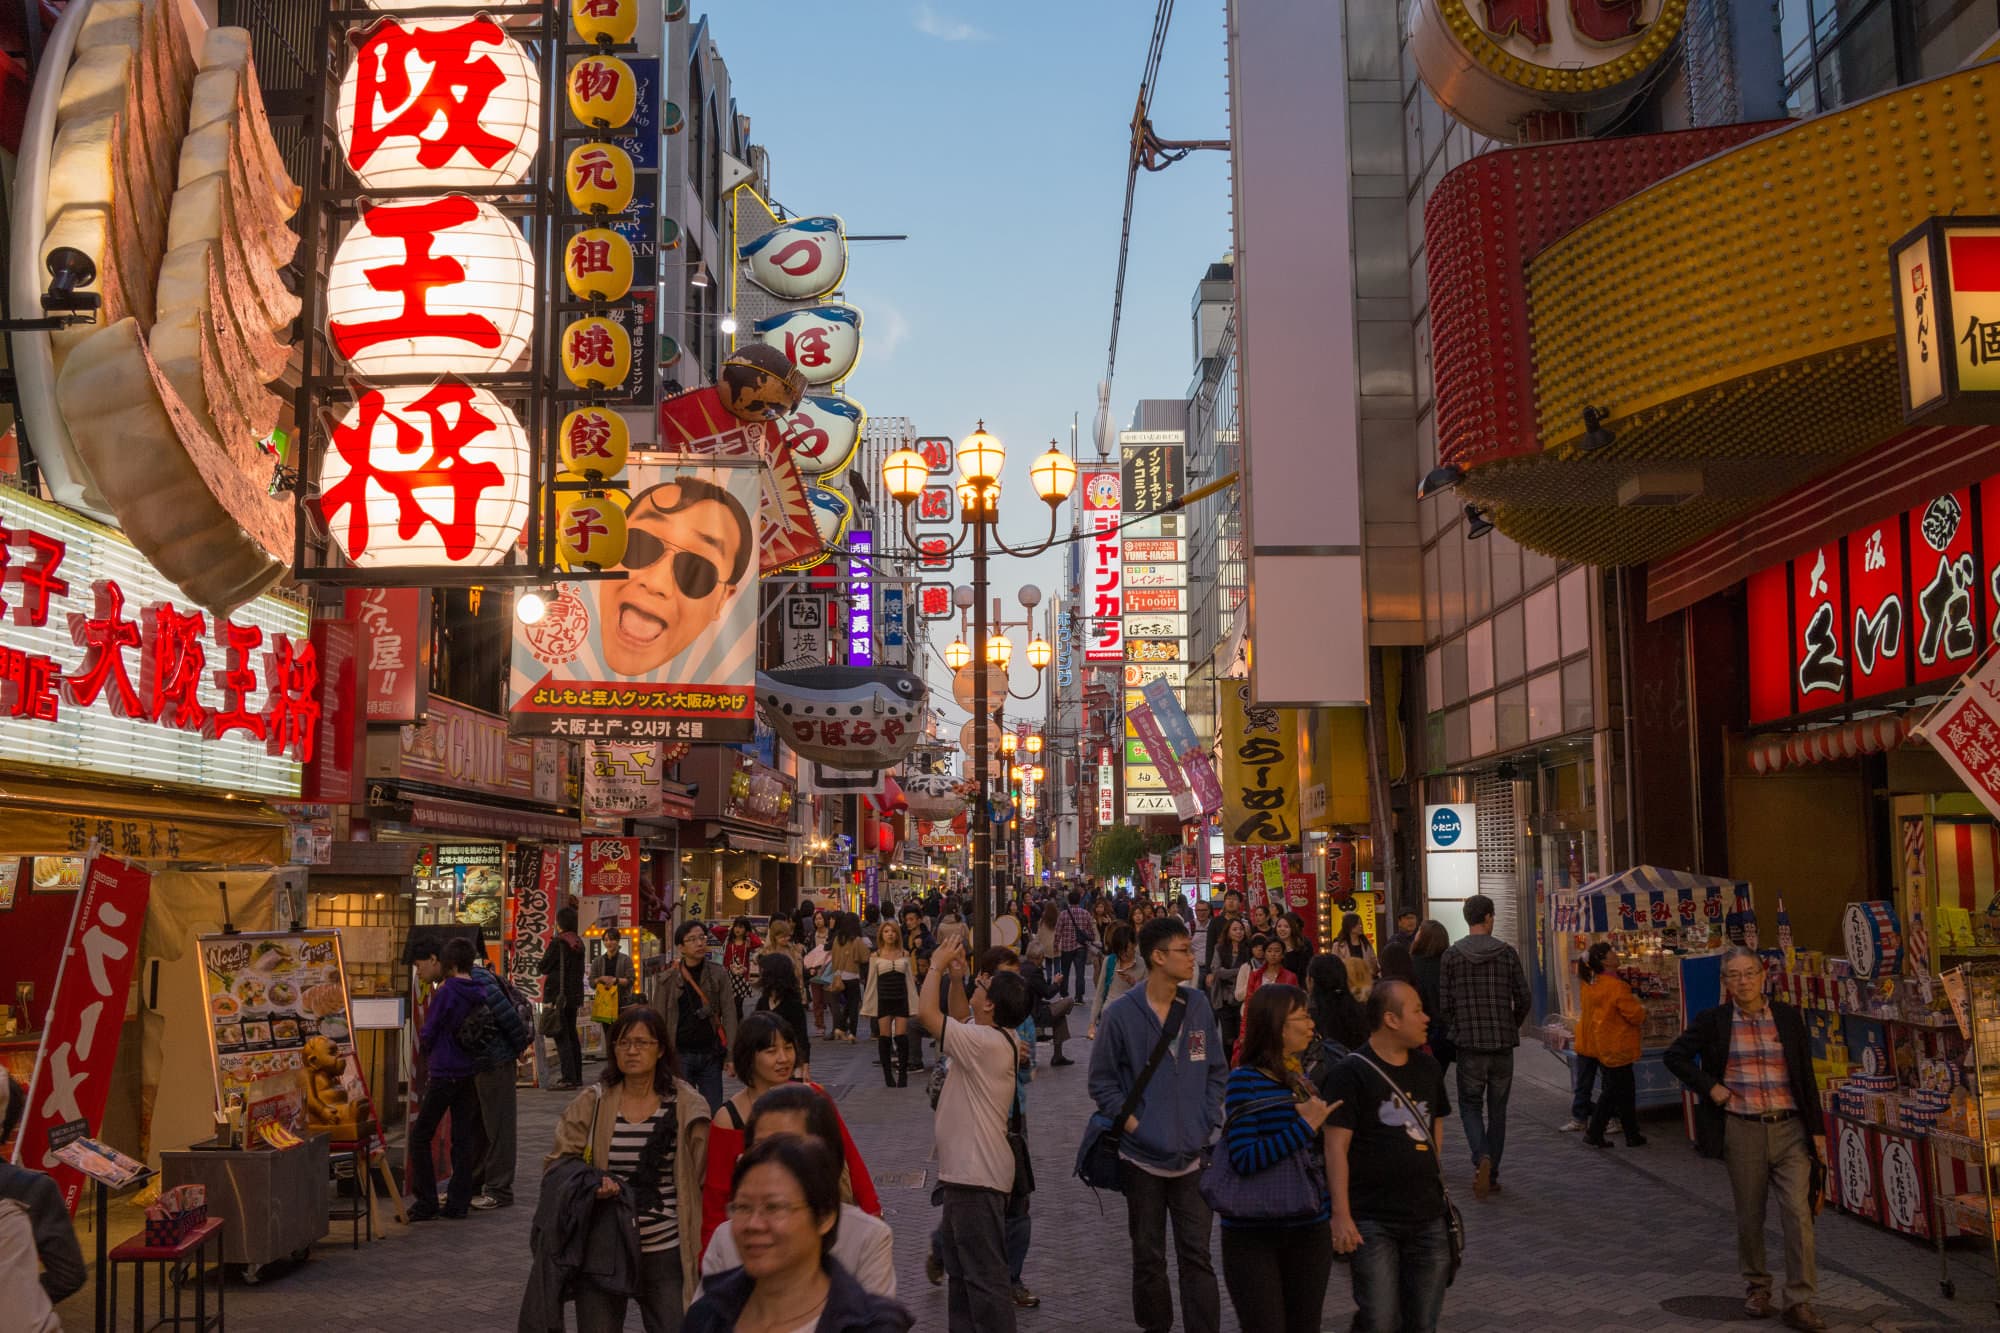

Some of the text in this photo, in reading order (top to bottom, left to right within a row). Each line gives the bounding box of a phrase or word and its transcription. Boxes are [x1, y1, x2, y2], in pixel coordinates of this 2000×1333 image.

[1147, 446, 1164, 511] インターネット
[0, 517, 69, 627] 子
[1094, 514, 1120, 648] ジャンカラ
[1799, 553, 2000, 695] くいだ
[67, 579, 320, 764] 大阪王将
[533, 688, 746, 712] よしもと芸人グッズ・大阪みやげ
[792, 718, 905, 747] づぼらや
[1230, 737, 1290, 842] らーめん
[1327, 847, 1342, 893] ラーメン
[1618, 895, 1722, 922] 大阪みやげ
[511, 888, 548, 998] お好み焼き
[41, 902, 128, 1168] ラーメ
